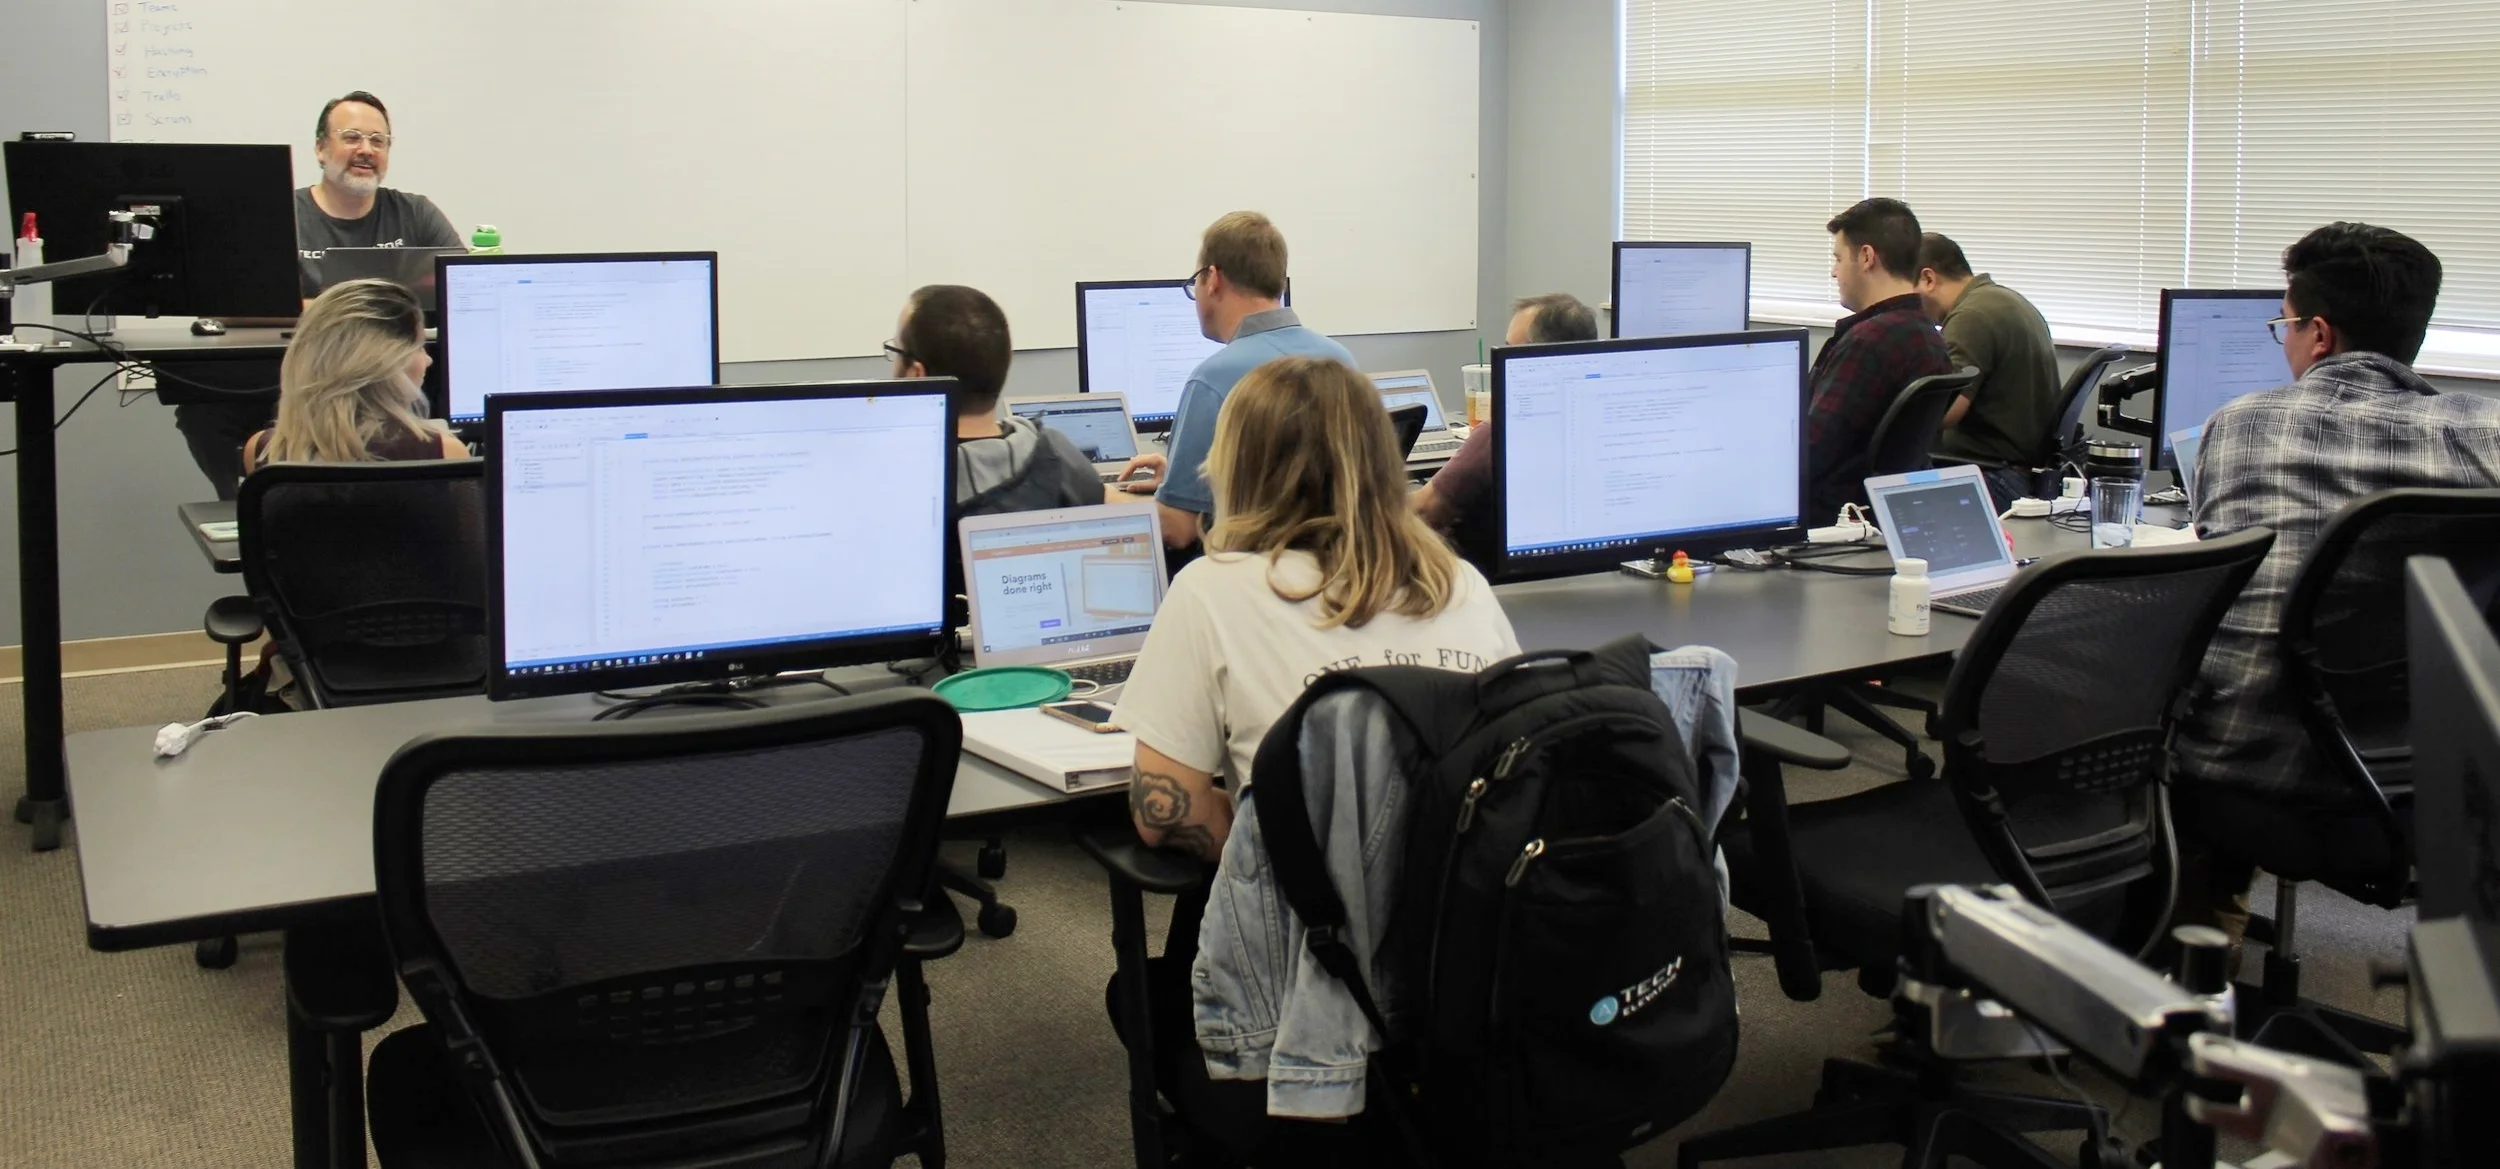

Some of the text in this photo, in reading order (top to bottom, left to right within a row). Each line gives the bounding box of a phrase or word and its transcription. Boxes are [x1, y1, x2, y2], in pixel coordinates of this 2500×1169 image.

[137, 1, 178, 13] Teams
[1001, 573, 1047, 585] Diagrams
[1003, 582, 1052, 595] done right
[1384, 649, 1421, 666] for
[1436, 648, 1488, 674] FUN
[1620, 956, 1682, 1003] TECH
